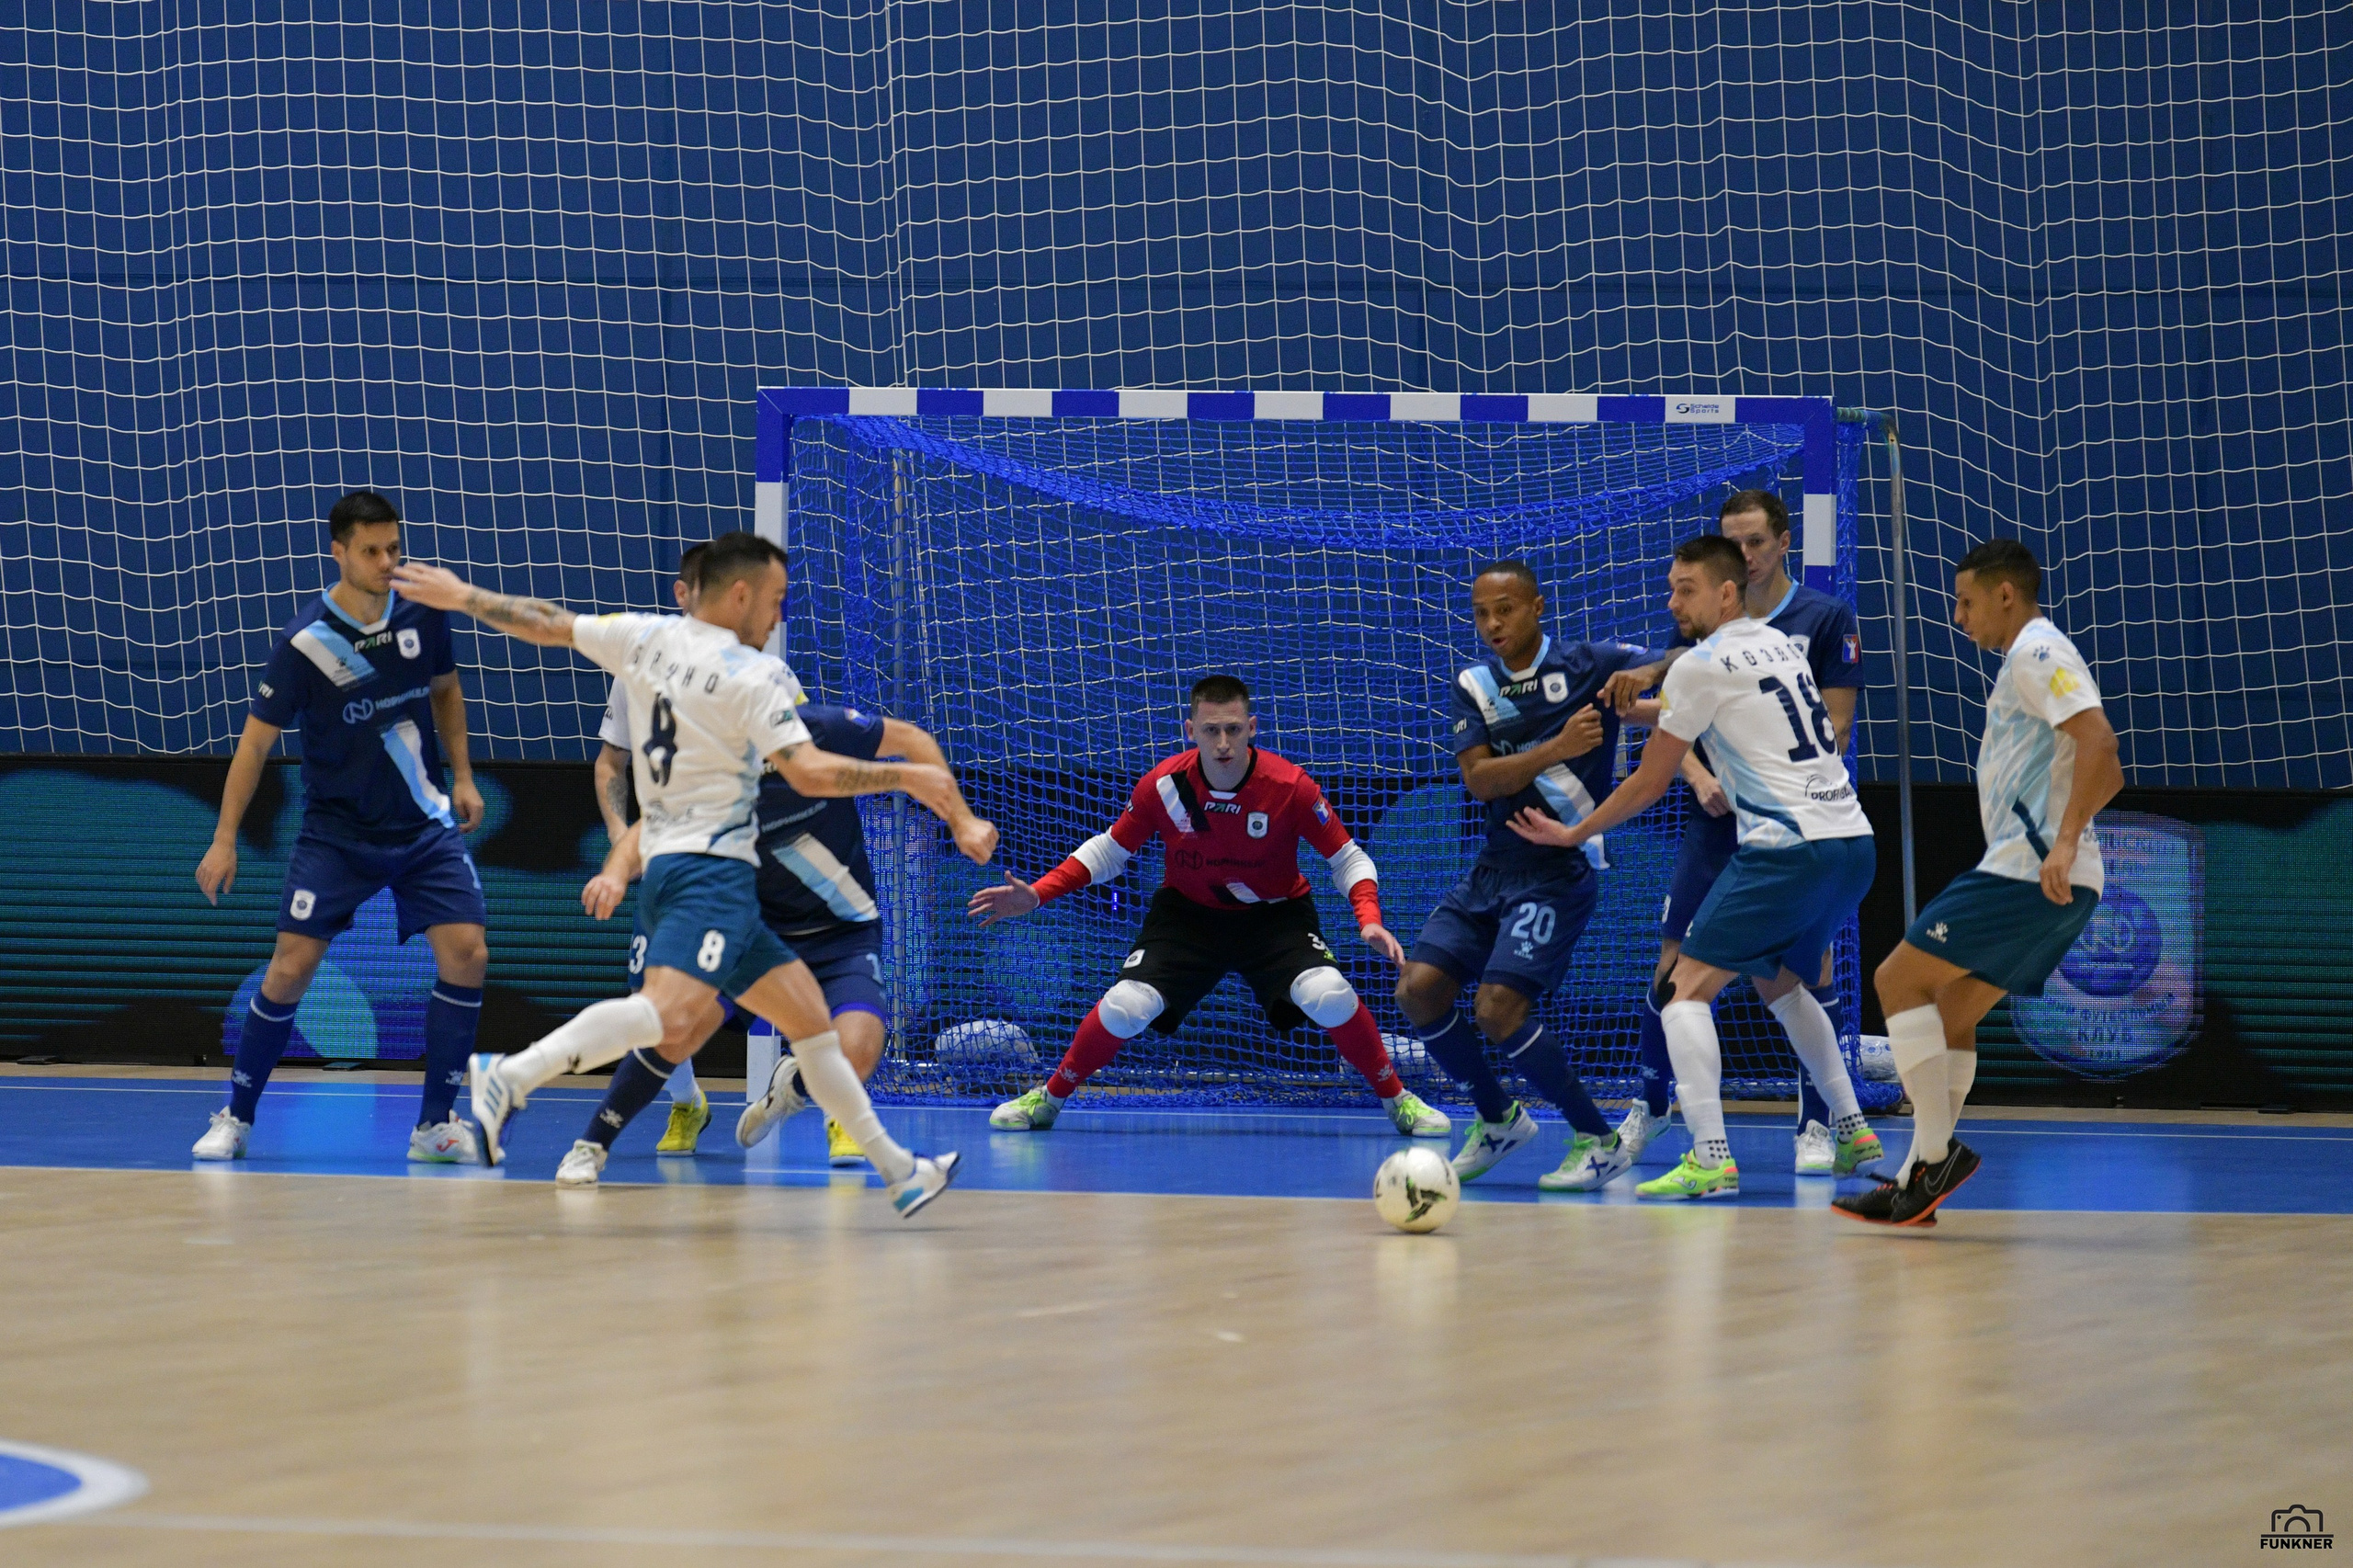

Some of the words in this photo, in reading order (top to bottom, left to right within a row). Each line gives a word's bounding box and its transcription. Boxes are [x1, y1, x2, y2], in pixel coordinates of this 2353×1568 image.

[354, 631, 393, 653] PARI
[1498, 678, 1539, 698] PARI
[1758, 672, 1840, 763] 18
[642, 692, 678, 787] 8
[1203, 801, 1242, 815] PARI
[1510, 902, 1556, 945] 20
[697, 929, 726, 972] 8
[1307, 932, 1331, 952] 3
